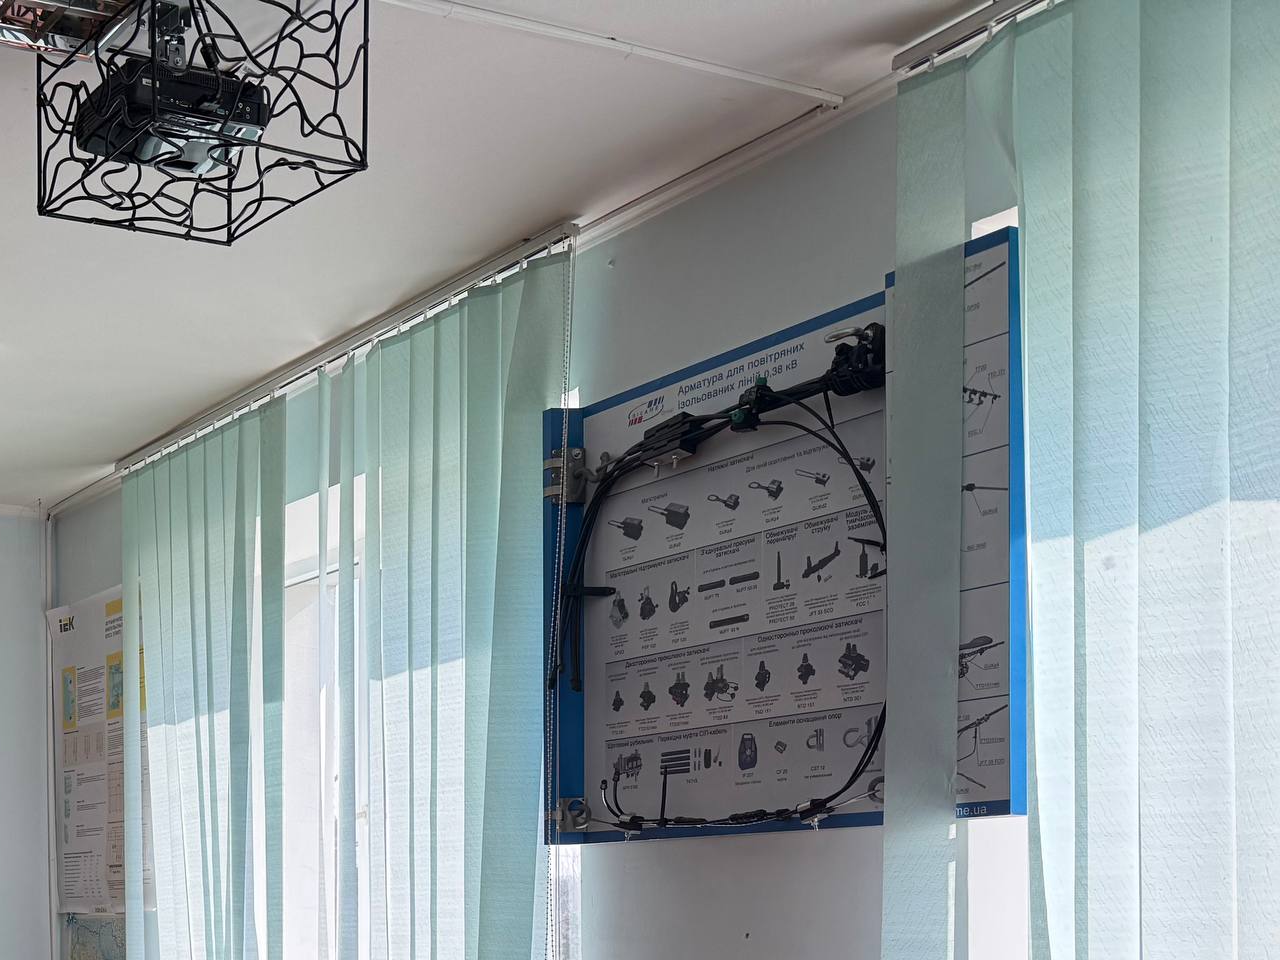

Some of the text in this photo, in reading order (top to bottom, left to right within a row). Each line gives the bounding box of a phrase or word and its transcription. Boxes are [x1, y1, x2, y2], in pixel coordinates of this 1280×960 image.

[677, 342, 805, 397] Арматура для повітряних
[785, 359, 798, 375] кВ
